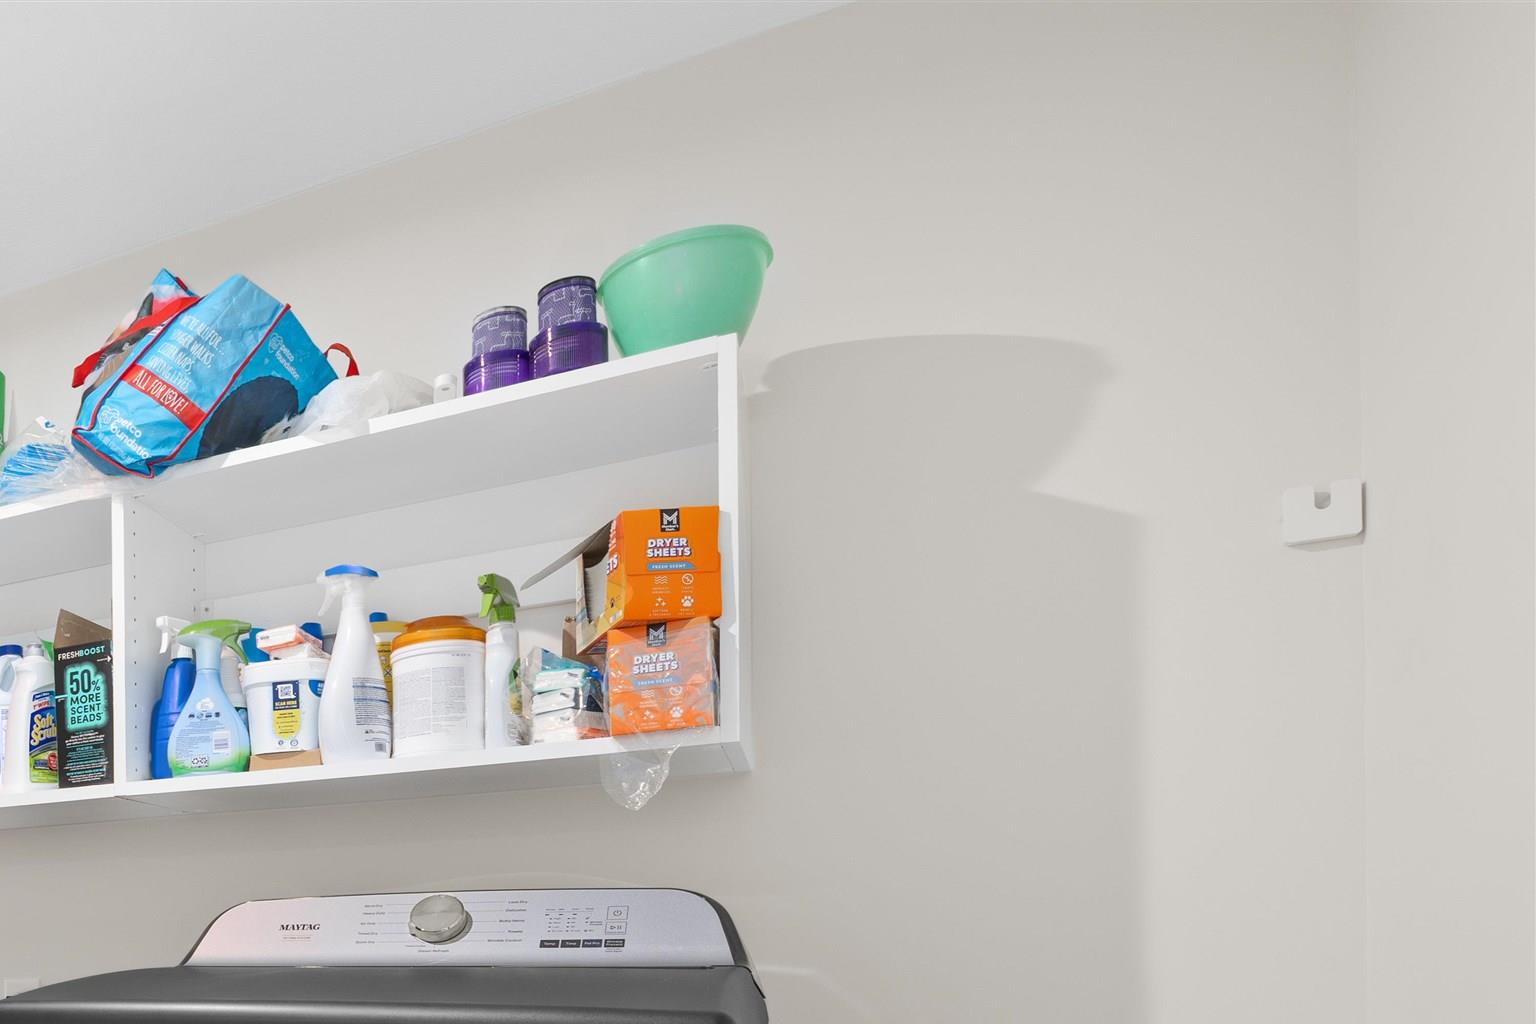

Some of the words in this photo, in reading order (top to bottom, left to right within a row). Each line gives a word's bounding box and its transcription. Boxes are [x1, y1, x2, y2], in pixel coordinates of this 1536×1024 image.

[132, 370, 151, 390] ALL
[147, 379, 166, 399] FOR
[648, 537, 688, 548] DRYER
[647, 547, 692, 558] SHEETS
[633, 652, 675, 665] DRYER
[632, 661, 678, 674] SHEETS
[70, 669, 101, 695] 50%
[70, 692, 101, 706] MORE
[70, 703, 101, 716] SCENT
[33, 712, 55, 731] Soft
[70, 712, 102, 725] BEADS
[279, 923, 321, 931] MAYTAG
